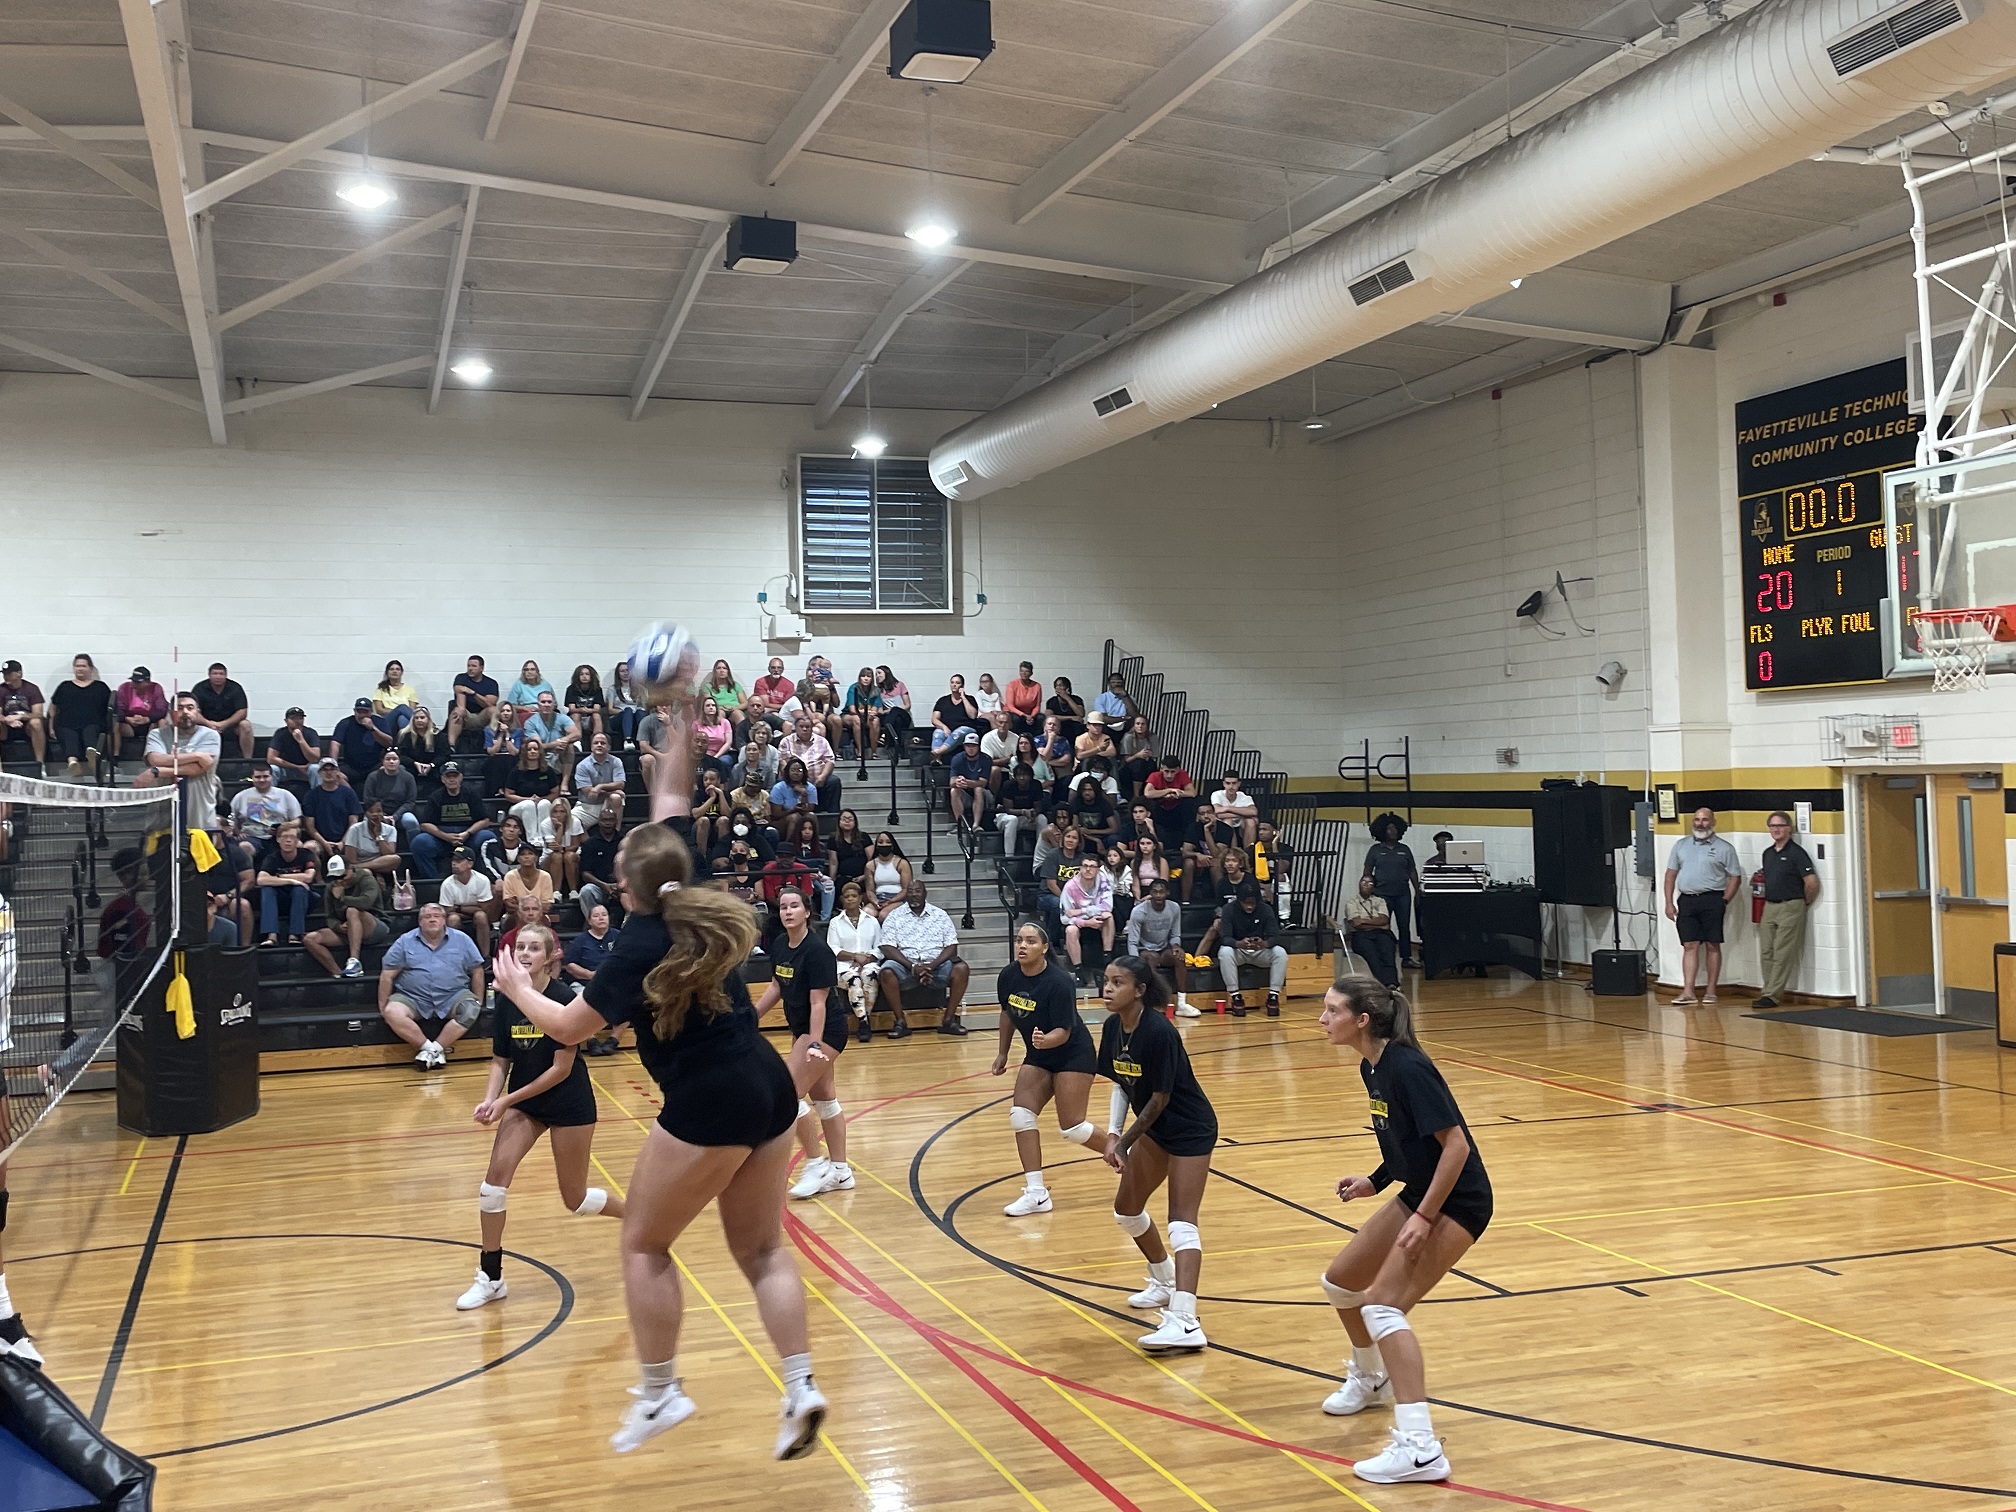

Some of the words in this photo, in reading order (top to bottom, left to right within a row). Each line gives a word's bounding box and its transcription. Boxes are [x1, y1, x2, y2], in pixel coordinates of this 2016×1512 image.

[1737, 407, 1839, 445] FAYETTEVILLE
[1751, 434, 1839, 468] COMMUNITY
[1843, 416, 1917, 446] COLLEGE
[1763, 544, 1796, 567] HOME
[1816, 545, 1852, 563] PERIOD
[1757, 570, 1794, 613] 20
[1836, 569, 1843, 596] 1
[1750, 623, 1773, 644] FLS
[1801, 616, 1834, 638] PLYR
[1841, 611, 1875, 634] FOUL
[1758, 650, 1773, 681] 0
